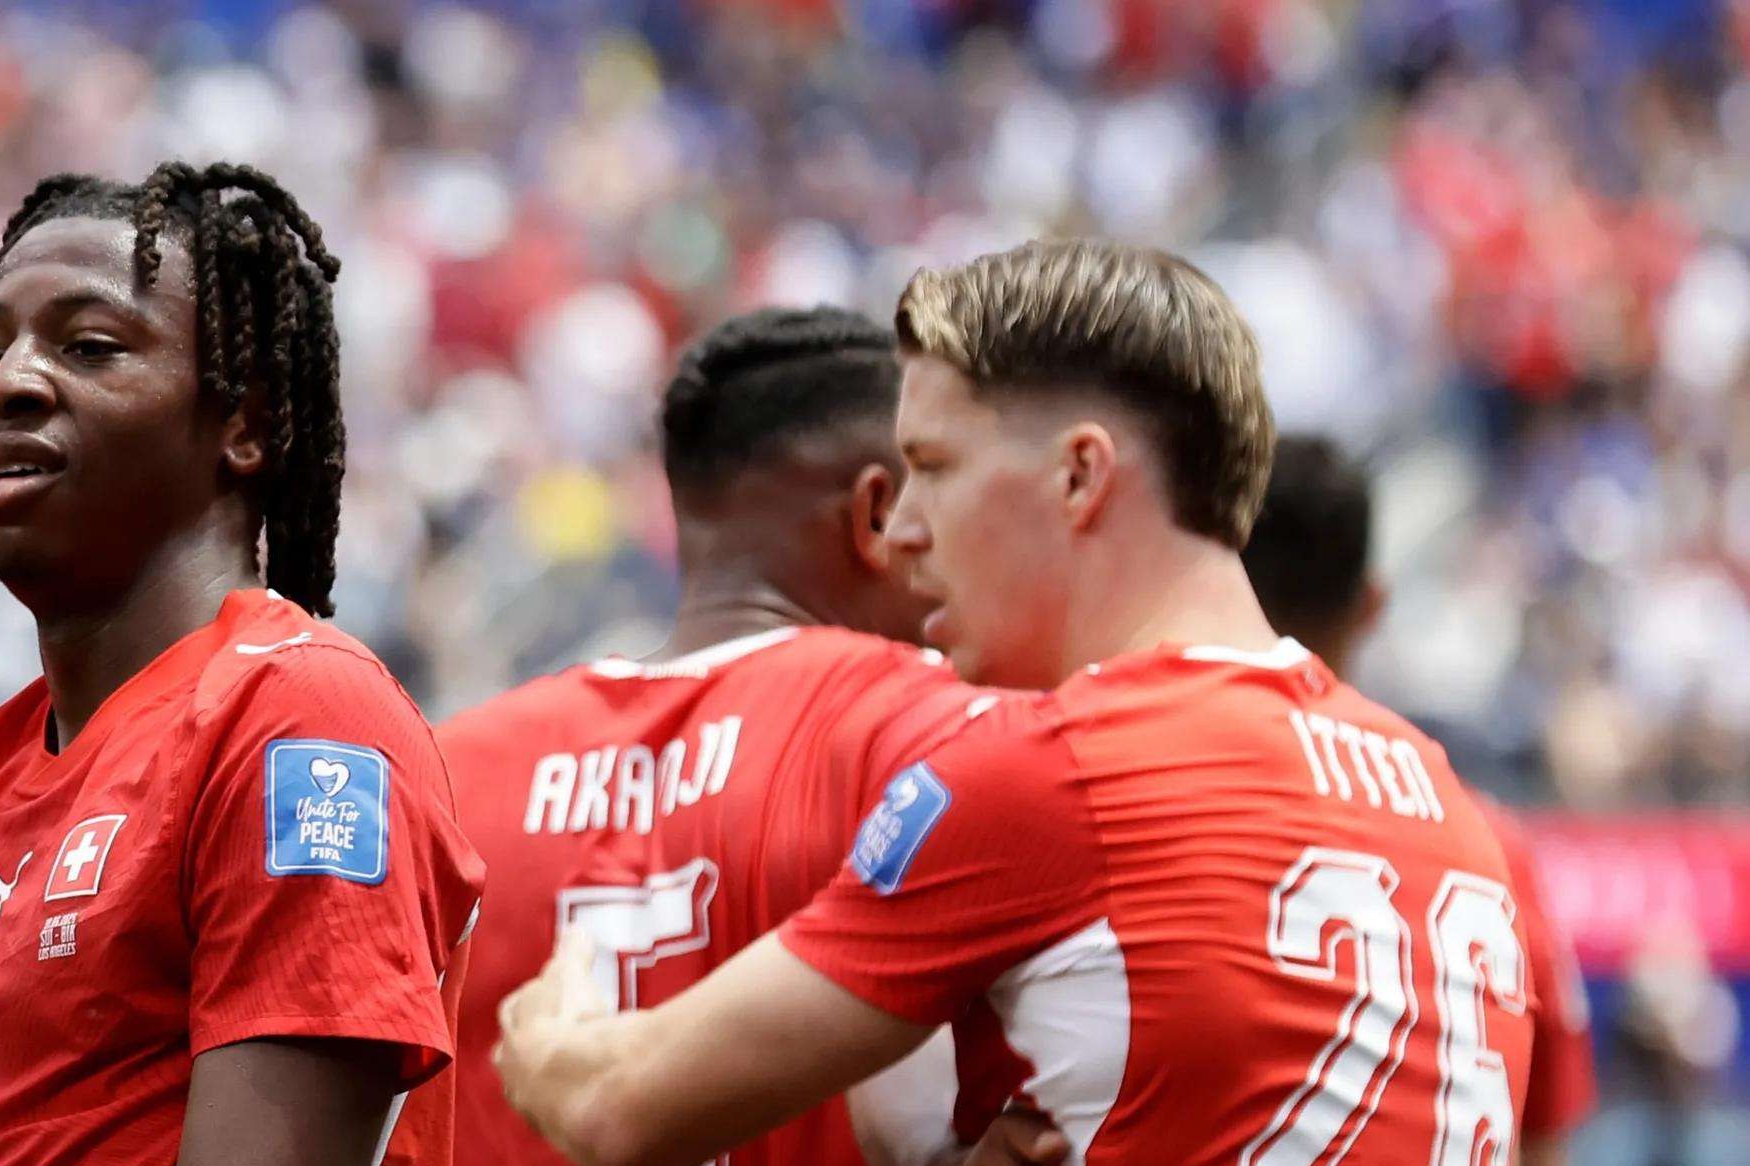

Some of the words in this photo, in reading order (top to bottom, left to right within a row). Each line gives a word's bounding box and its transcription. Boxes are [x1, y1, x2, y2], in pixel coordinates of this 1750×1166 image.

[524, 715, 742, 834] AKANJI
[1288, 709, 1445, 823] ITTEN
[296, 797, 337, 821] Unite
[336, 801, 360, 823] For
[299, 821, 355, 850] PEACE
[310, 846, 341, 861] FIFA
